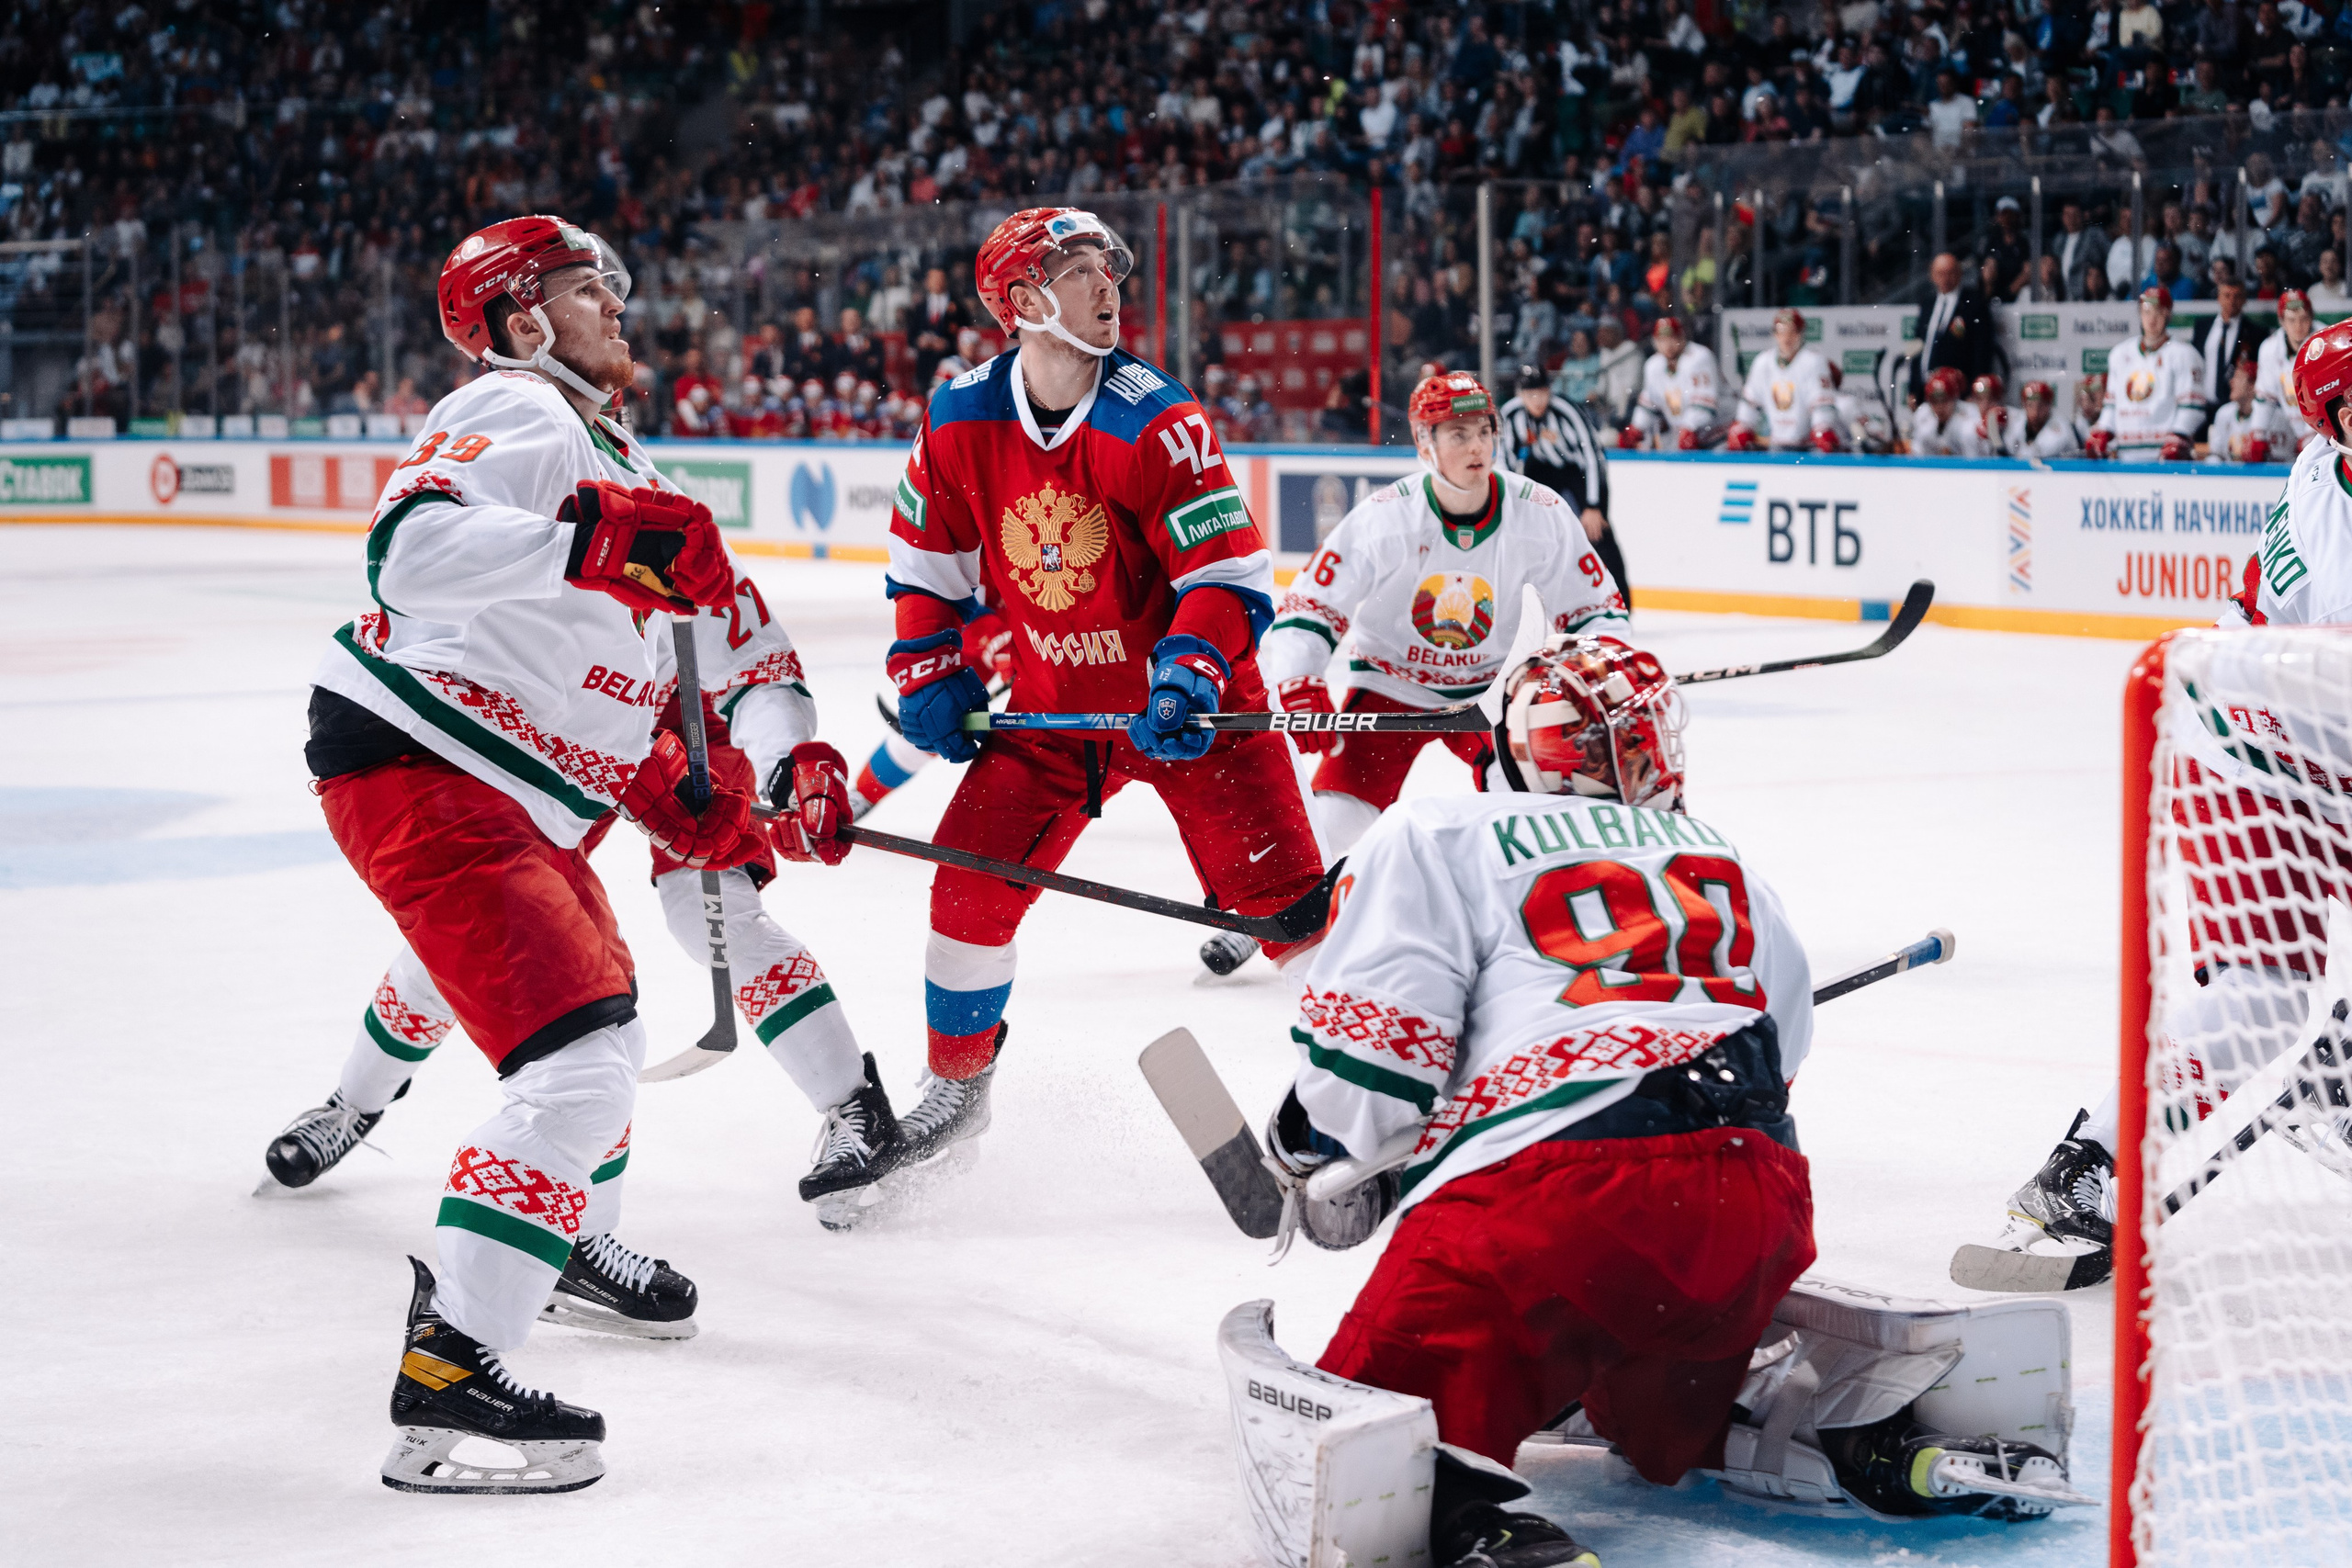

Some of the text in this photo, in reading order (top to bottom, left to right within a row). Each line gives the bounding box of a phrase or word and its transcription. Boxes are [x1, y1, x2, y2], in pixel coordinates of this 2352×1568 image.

[473, 271, 508, 295] CCM
[2314, 378, 2340, 396] CCM
[398, 431, 494, 470] 39
[1158, 413, 1223, 475] 42
[1188, 516, 1223, 543] ЛИГА
[2080, 490, 2164, 532] ХОККЕЙ
[597, 536, 610, 567] CCM
[1768, 500, 1861, 567] ВТБ
[1577, 552, 1607, 588] 9
[2117, 550, 2233, 602] JUNIOR
[710, 577, 771, 651] 27
[893, 652, 961, 690] CCM
[690, 722, 702, 749] TRIGGER
[1269, 713, 1378, 732] BAUER
[1492, 805, 1740, 866] KULBAKO
[702, 893, 729, 969] CCM
[1519, 852, 1768, 1011] 90
[577, 1278, 619, 1303] BAUER
[466, 1387, 514, 1413] BAUER
[1249, 1377, 1332, 1422] BAUER
